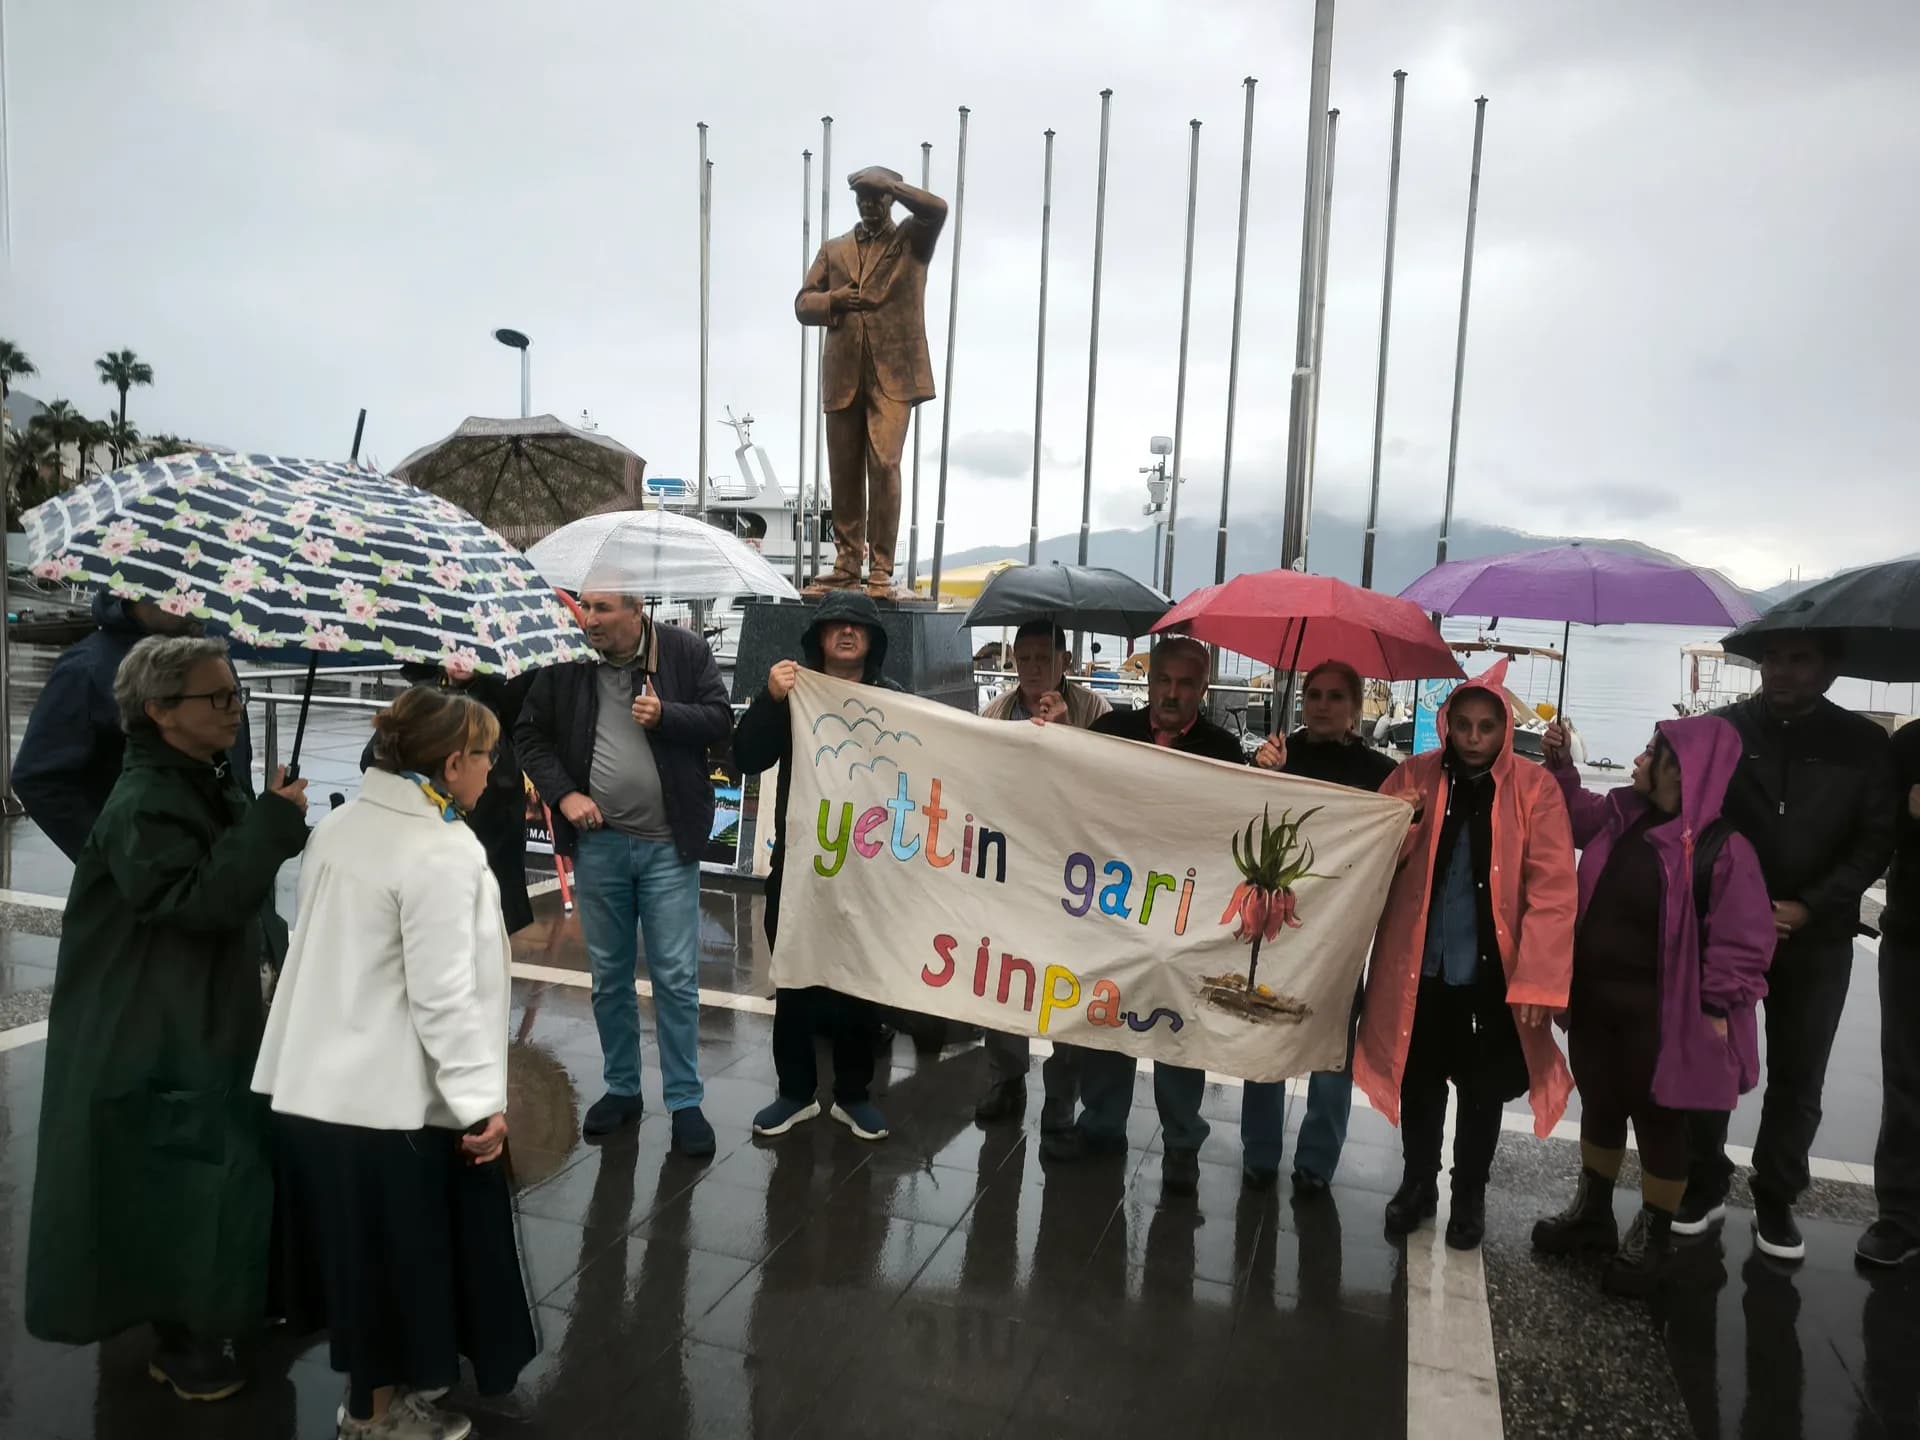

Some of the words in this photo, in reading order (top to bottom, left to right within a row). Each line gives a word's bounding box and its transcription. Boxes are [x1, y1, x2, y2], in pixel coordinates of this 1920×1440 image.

[526, 827, 552, 841] MAL
[813, 772, 1007, 884] yettin
[1061, 850, 1197, 937] gari
